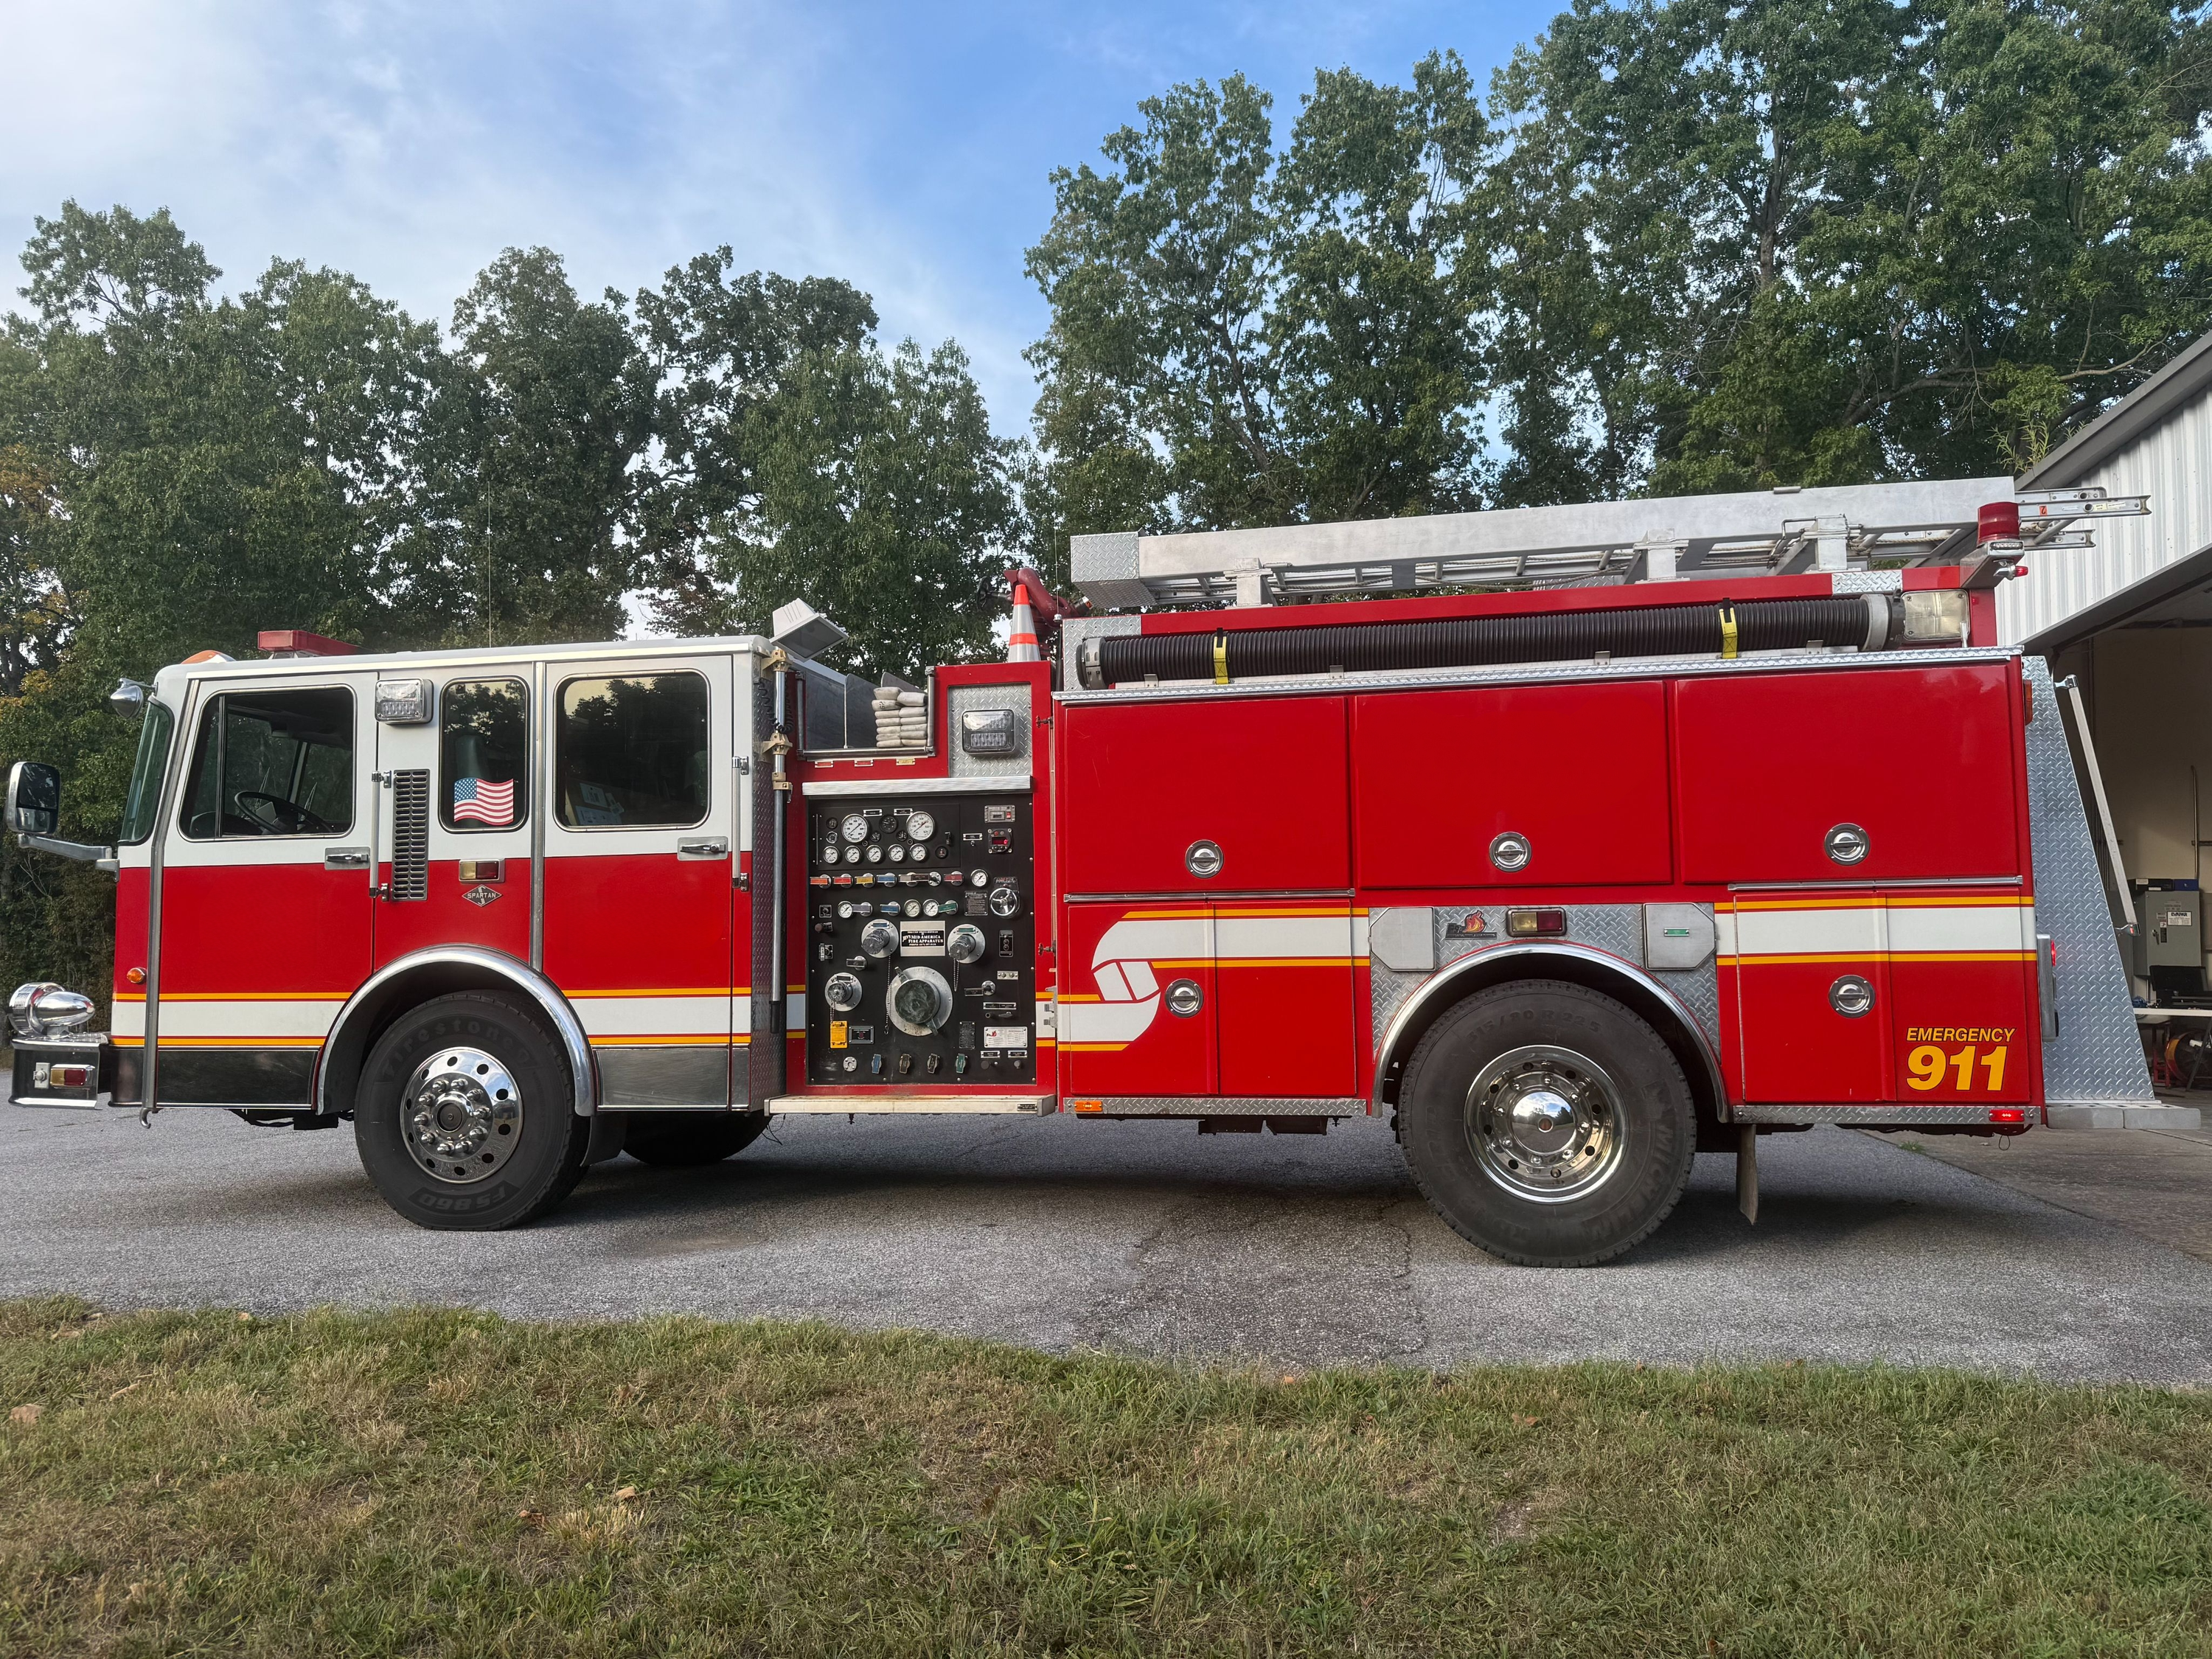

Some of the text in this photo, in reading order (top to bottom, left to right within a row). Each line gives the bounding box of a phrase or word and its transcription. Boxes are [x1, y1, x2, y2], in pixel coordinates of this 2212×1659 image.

[380, 1018, 515, 1082] Firestone
[1906, 1027, 2017, 1042] EMERGENCY
[1906, 1045, 2008, 1091] 911
